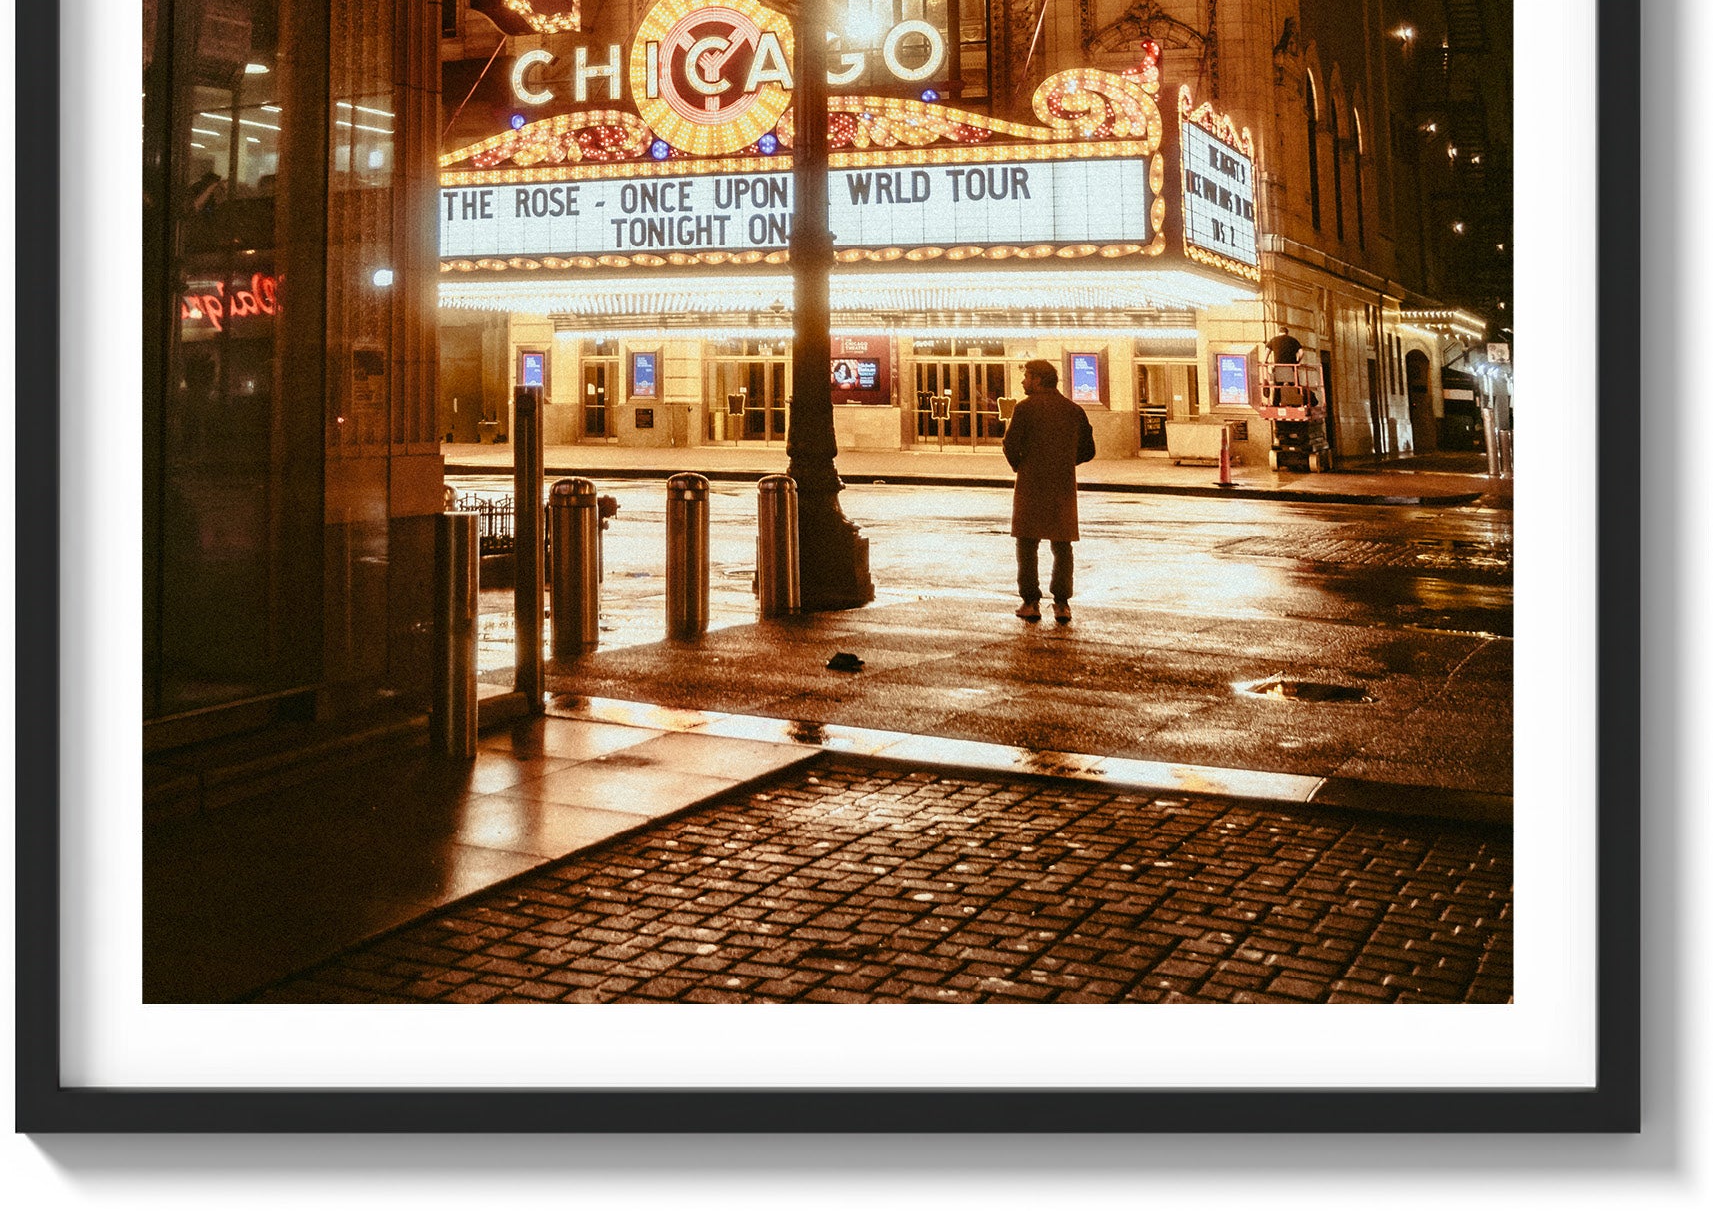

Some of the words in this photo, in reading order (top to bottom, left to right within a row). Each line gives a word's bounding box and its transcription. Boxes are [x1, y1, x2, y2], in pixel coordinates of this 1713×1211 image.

[443, 189, 494, 221] THE
[515, 185, 580, 219] ROSE
[620, 180, 694, 214] ONCE
[714, 176, 788, 210] UPON
[846, 170, 931, 206] WRLD
[946, 167, 1031, 202] TOUR
[611, 215, 731, 248] TONIGHT
